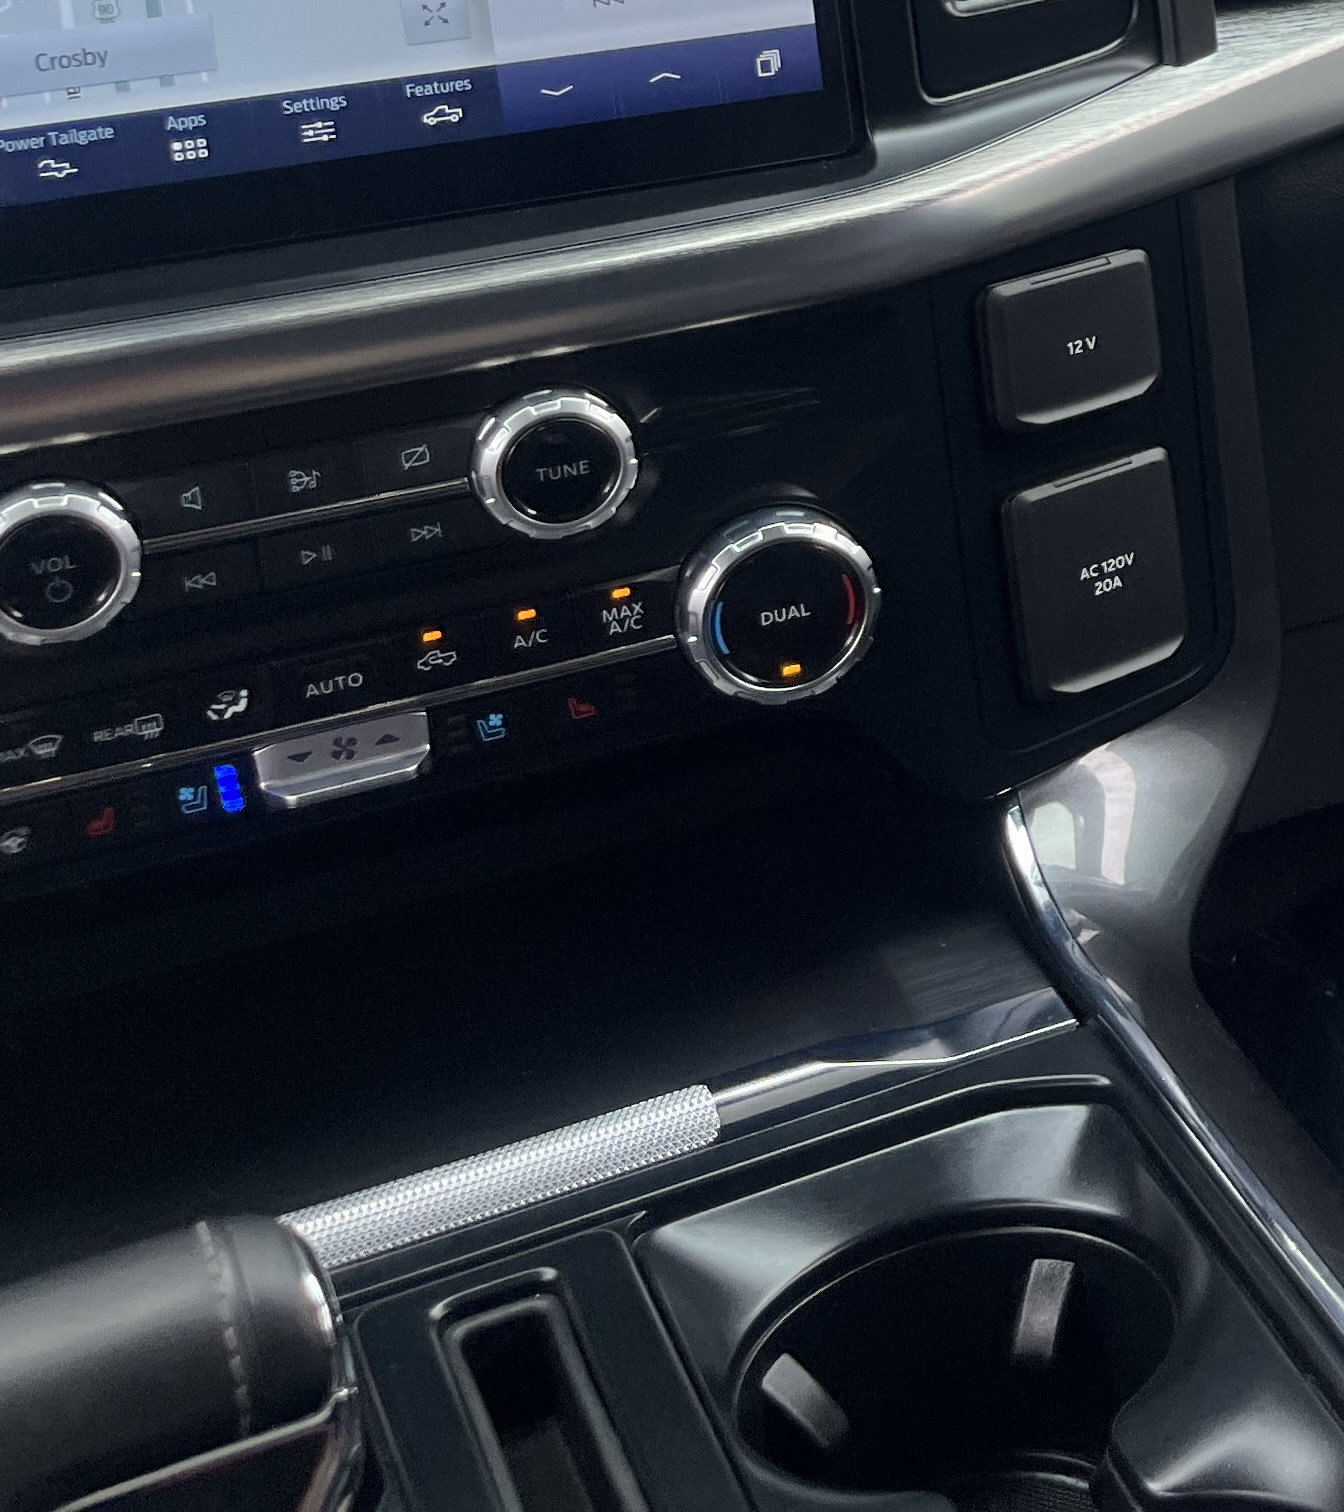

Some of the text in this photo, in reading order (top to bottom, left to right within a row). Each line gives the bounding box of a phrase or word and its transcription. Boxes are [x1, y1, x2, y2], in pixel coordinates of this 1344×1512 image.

[34, 46, 108, 72] Crosby
[405, 77, 472, 98] Features
[282, 92, 348, 116] Settings
[166, 112, 206, 131] Apps
[0, 123, 114, 153] Power Tailgate
[1066, 336, 1097, 356] 12 V
[536, 459, 590, 482] TUNE
[30, 555, 76, 574] VOL
[1080, 552, 1134, 581] AC 120V
[1094, 576, 1122, 596] 20A
[602, 602, 644, 624] MAX
[760, 604, 811, 626] DUAL
[608, 616, 642, 636] A/C
[513, 629, 548, 650] A/C
[306, 672, 363, 696] AUTO
